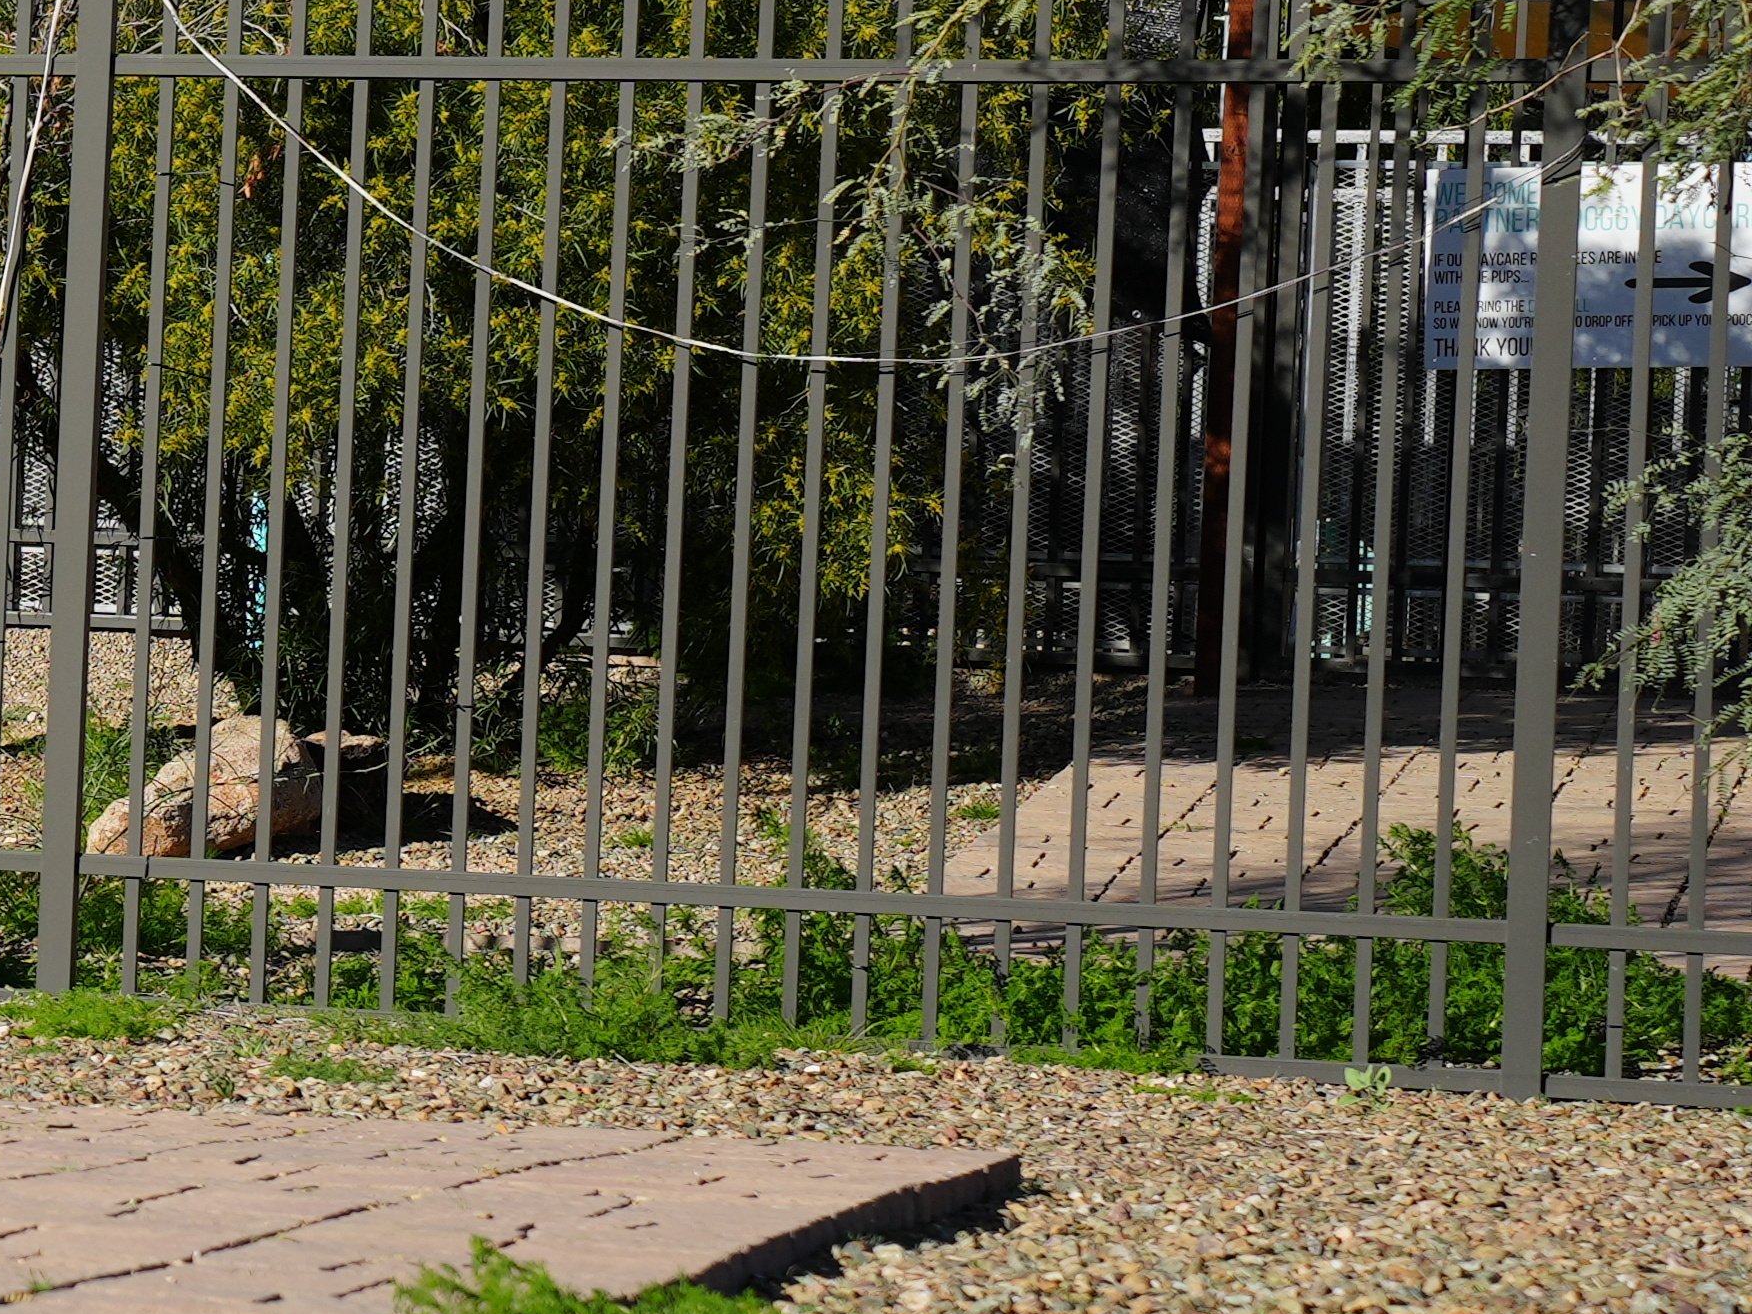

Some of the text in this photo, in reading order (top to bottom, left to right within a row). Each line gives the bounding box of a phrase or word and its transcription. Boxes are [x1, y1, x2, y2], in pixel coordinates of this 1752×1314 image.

[1436, 181, 1538, 205] WECOME
[1434, 253, 1445, 267] IF
[1446, 252, 1463, 267] OU
[1480, 252, 1527, 266] AYCARE
[1598, 250, 1622, 265] ARE
[1434, 269, 1463, 284] WITH
[1503, 300, 1526, 313] THE
[1433, 317, 1447, 330] SO
[1584, 315, 1613, 328] DROP
[1614, 314, 1634, 327] OFF
[1652, 314, 1676, 327] PICK
[1678, 314, 1692, 327] UP
[1496, 337, 1534, 357] YOU!
